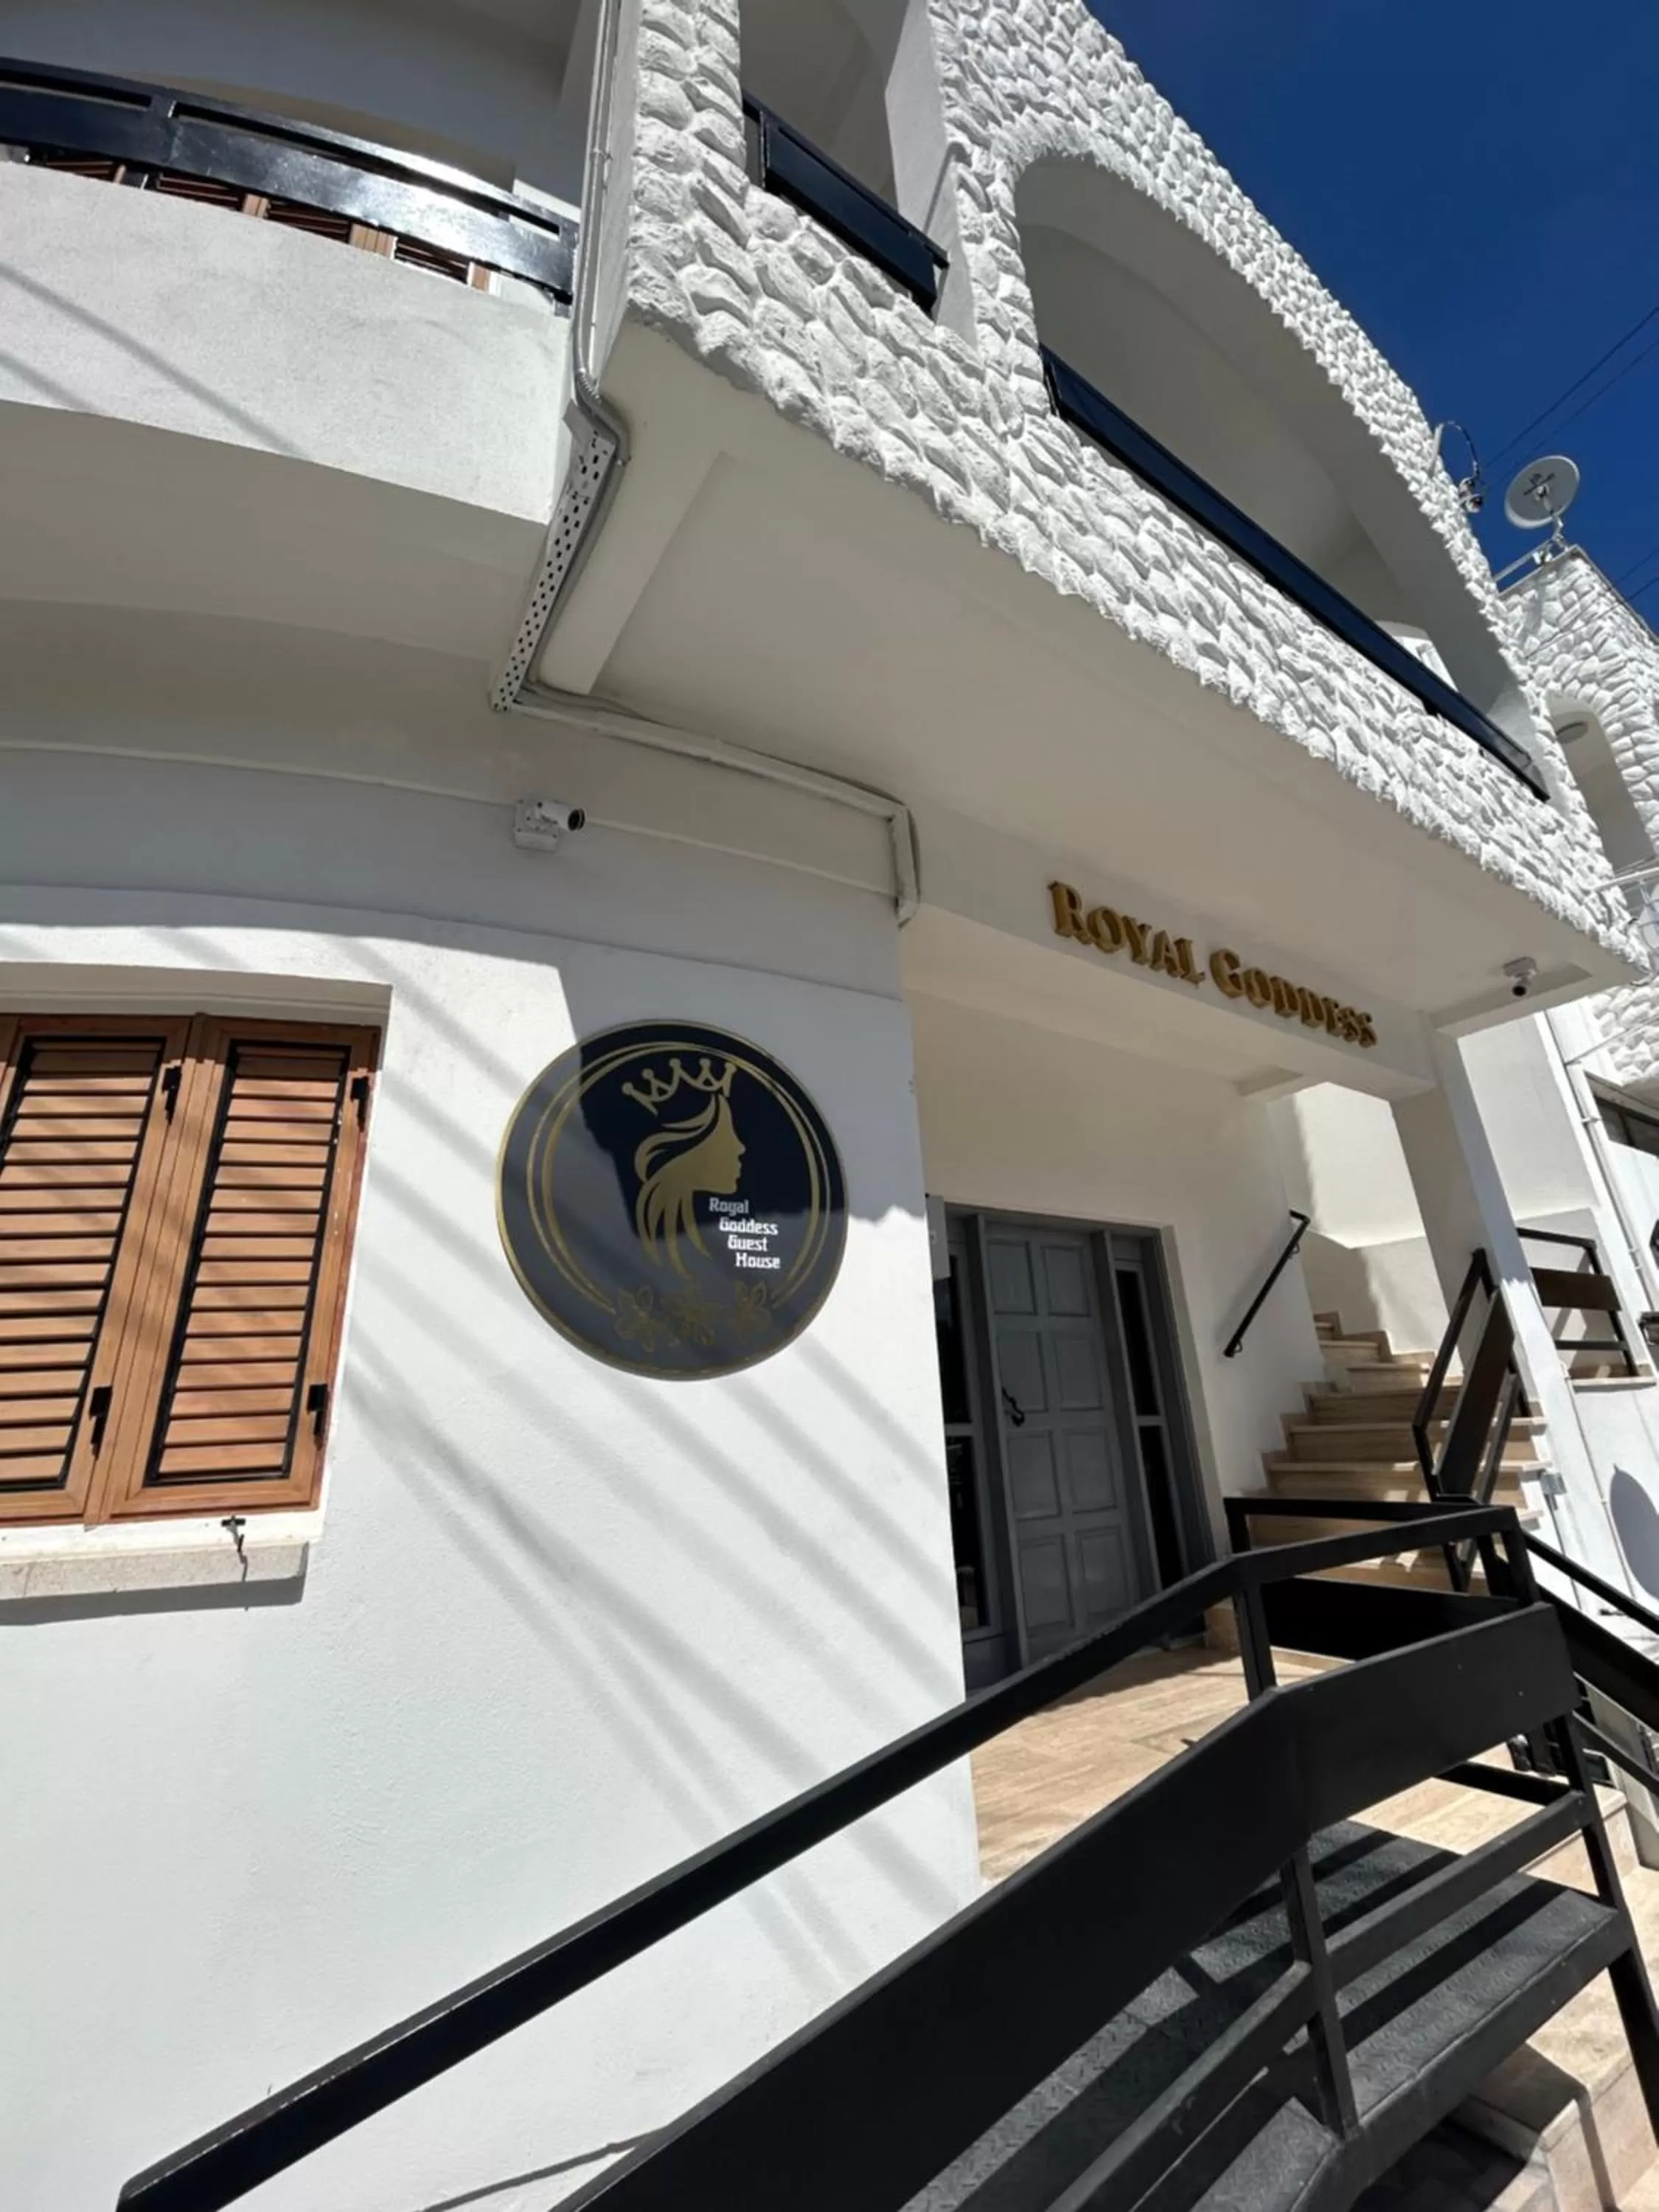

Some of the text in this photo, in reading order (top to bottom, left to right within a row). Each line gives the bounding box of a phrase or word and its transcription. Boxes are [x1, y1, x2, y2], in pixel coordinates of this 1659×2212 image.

[1048, 880, 1377, 1048] ROYAL GODDESS
[709, 1197, 749, 1216] Royal
[719, 1217, 779, 1235] Goddess
[727, 1234, 768, 1251] Guest
[735, 1252, 780, 1269] House
